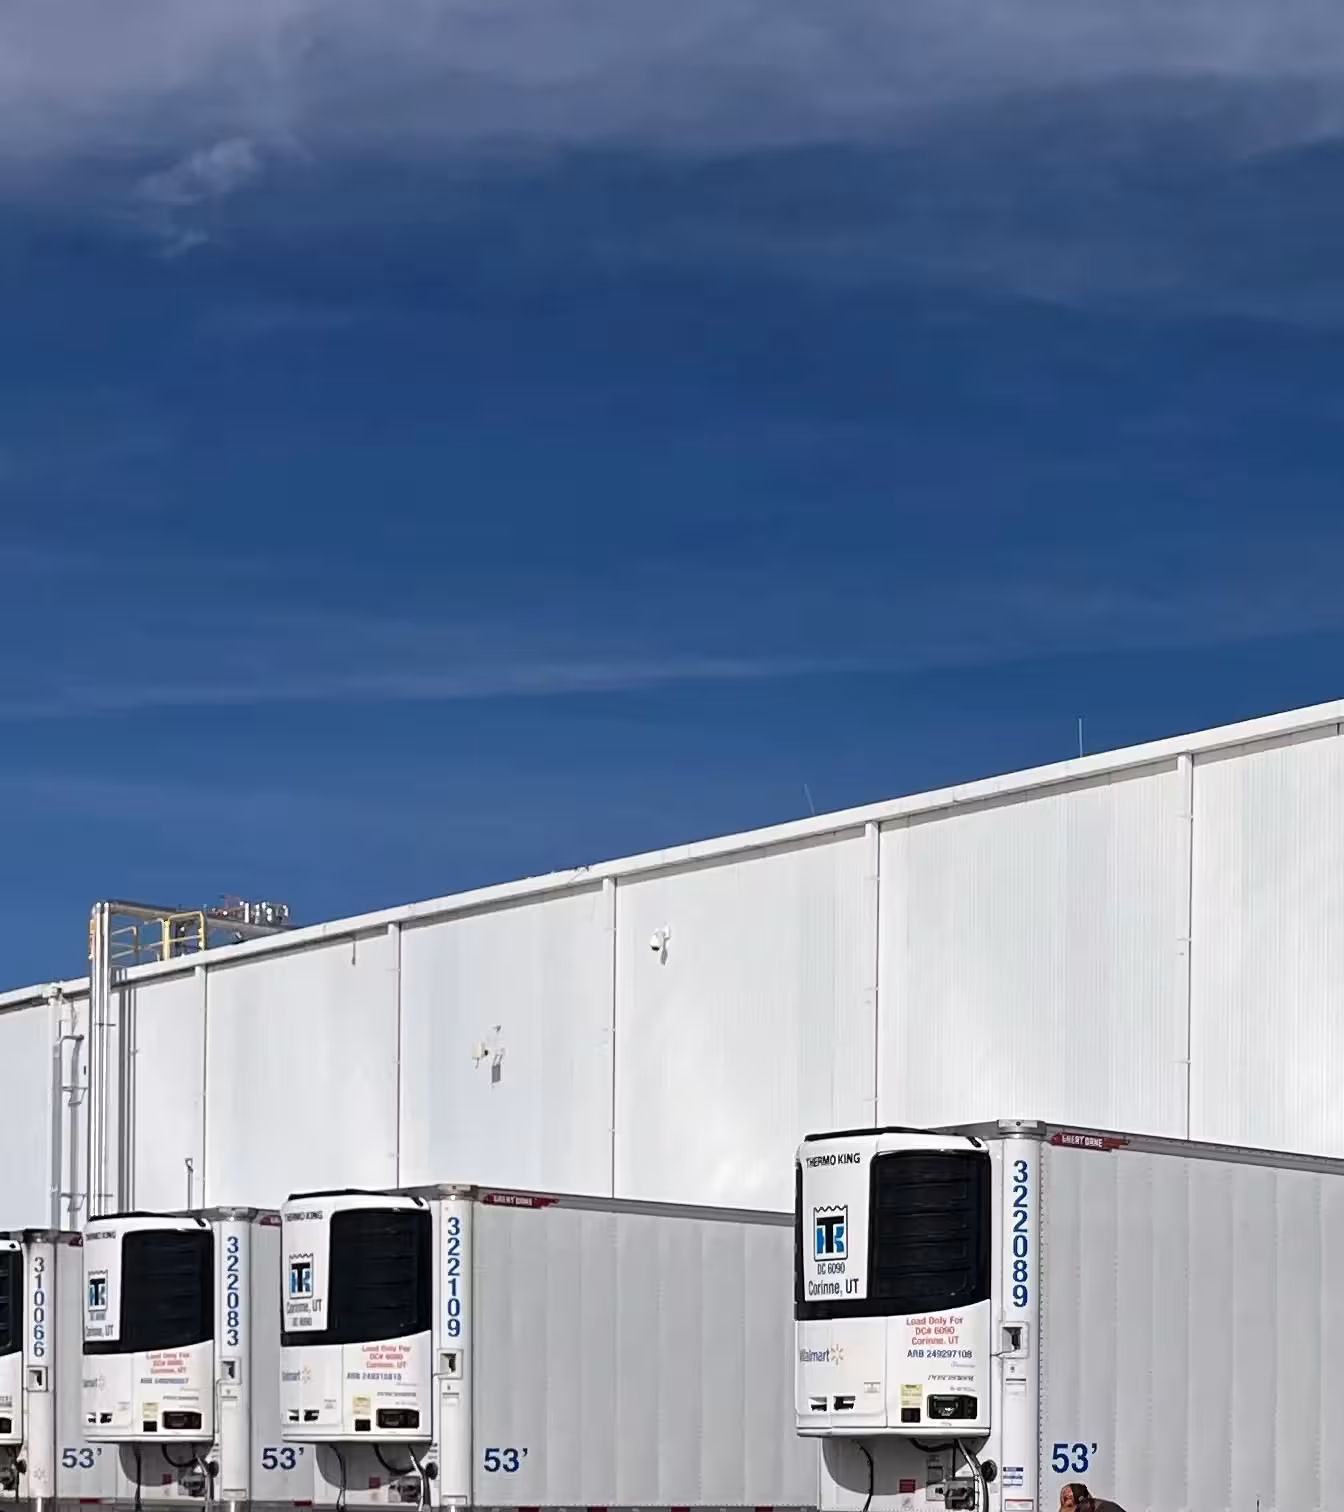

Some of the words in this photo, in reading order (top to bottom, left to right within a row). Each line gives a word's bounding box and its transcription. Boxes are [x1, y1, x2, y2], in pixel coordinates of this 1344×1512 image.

[837, 1153, 861, 1165] KING
[1012, 1159, 1028, 1308] 322089
[817, 1263, 827, 1275] DC
[827, 1262, 846, 1274] 6090
[447, 1216, 461, 1338] 322109
[226, 1236, 240, 1347] 322083
[808, 1280, 844, 1298] Corinne,
[845, 1279, 860, 1294] UT
[33, 1256, 45, 1358] 310066
[906, 1317, 927, 1326] Load
[949, 1315, 964, 1325] For
[915, 1327, 932, 1336] DC#
[934, 1326, 956, 1335] 6090
[948, 1335, 960, 1345] UT
